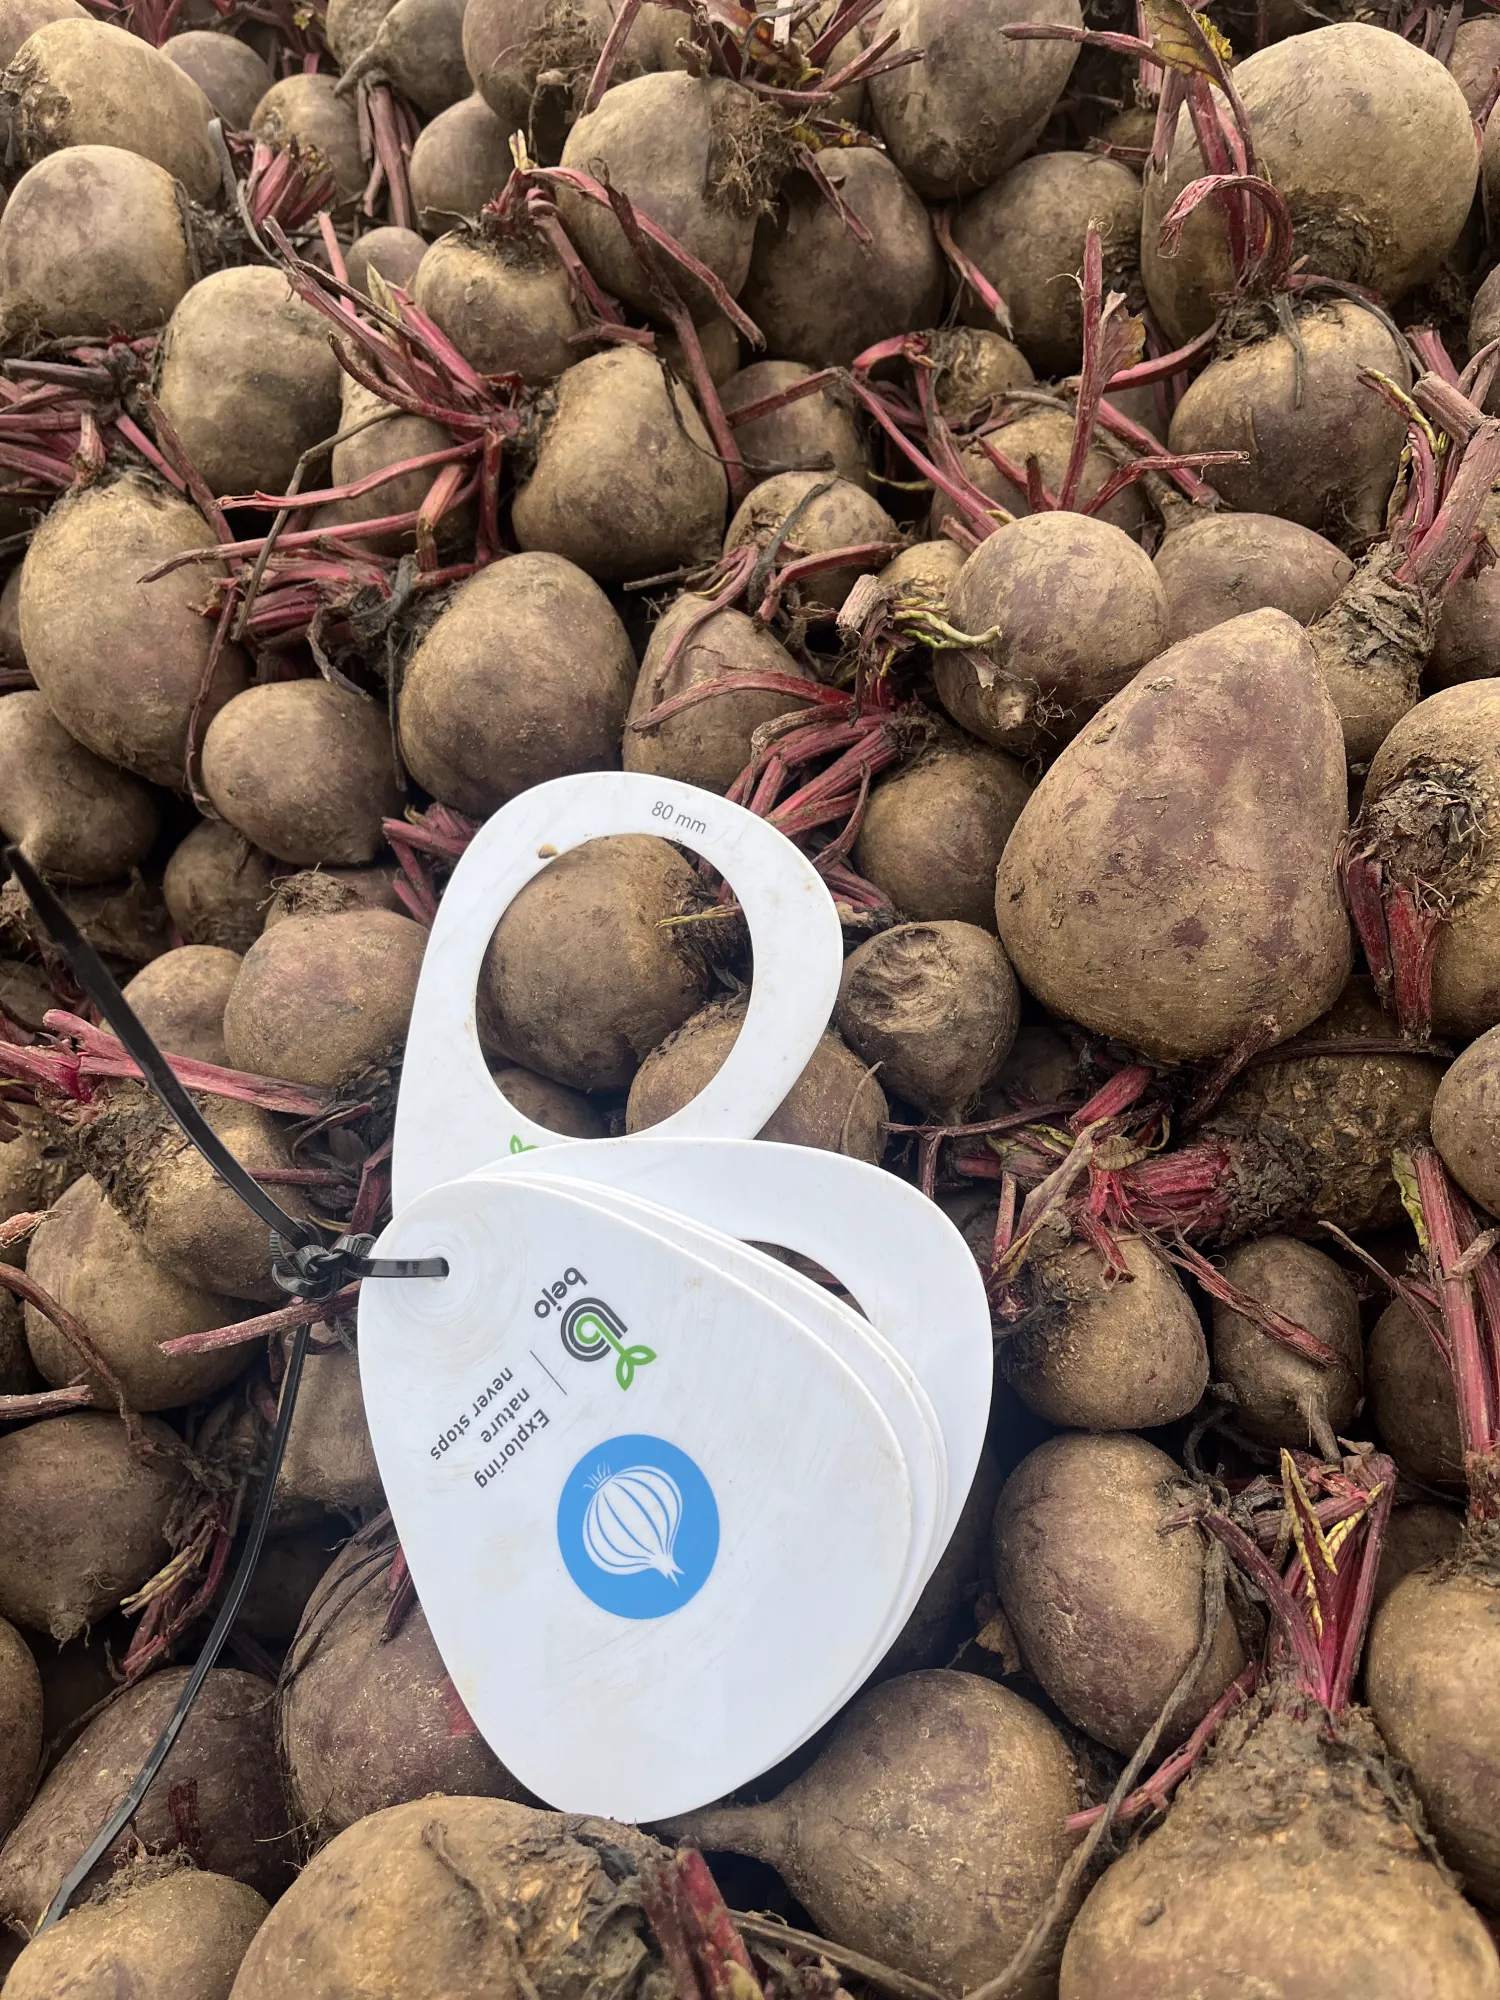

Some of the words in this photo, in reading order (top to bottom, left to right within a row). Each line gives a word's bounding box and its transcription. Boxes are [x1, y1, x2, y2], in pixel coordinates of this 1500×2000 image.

[651, 800, 674, 820] 80
[675, 813, 707, 834] mm
[534, 1267, 588, 1319] bejo
[474, 1367, 514, 1418] never
[480, 1387, 531, 1443] nature
[430, 1416, 471, 1460] stops
[473, 1408, 550, 1489] Exploring
